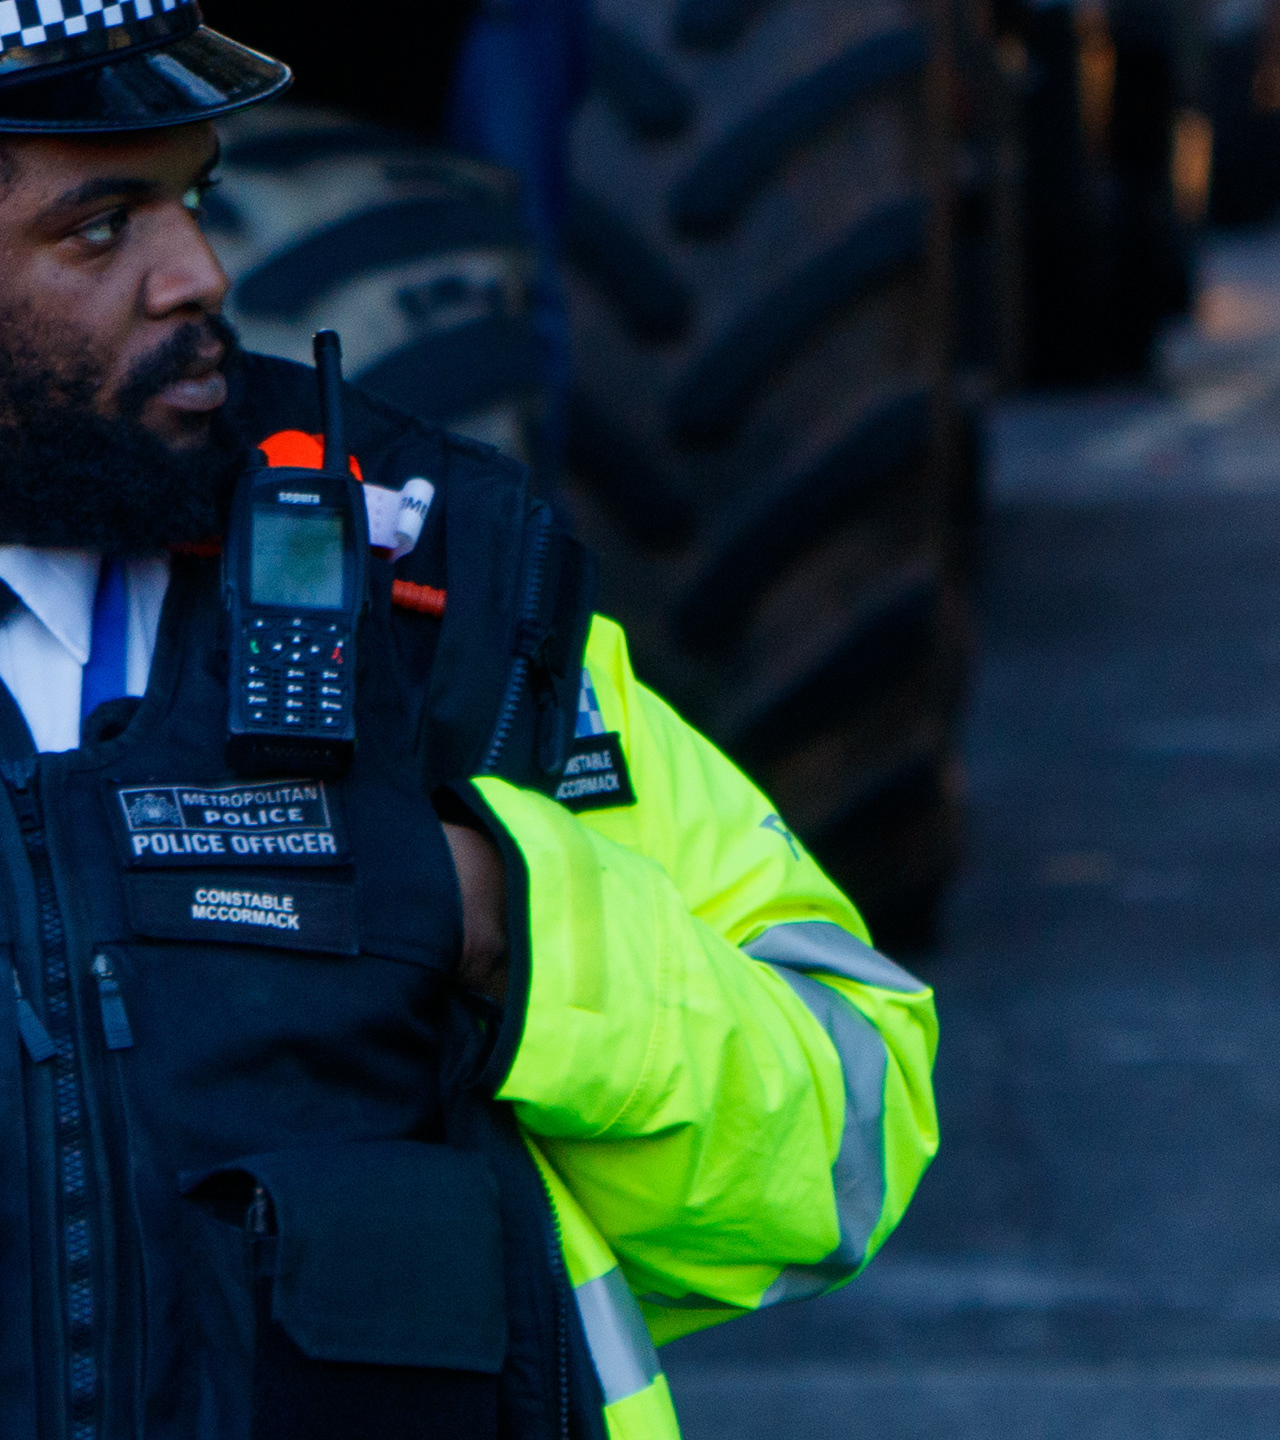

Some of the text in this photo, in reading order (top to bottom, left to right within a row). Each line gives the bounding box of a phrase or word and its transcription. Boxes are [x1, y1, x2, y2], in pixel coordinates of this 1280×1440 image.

[182, 787, 318, 808] METROPOLITAN
[203, 808, 304, 826] POLICE
[132, 832, 338, 856] POLICE OFFICER
[195, 888, 294, 912] CONSTABLE
[191, 905, 300, 930] MCCORMACK
